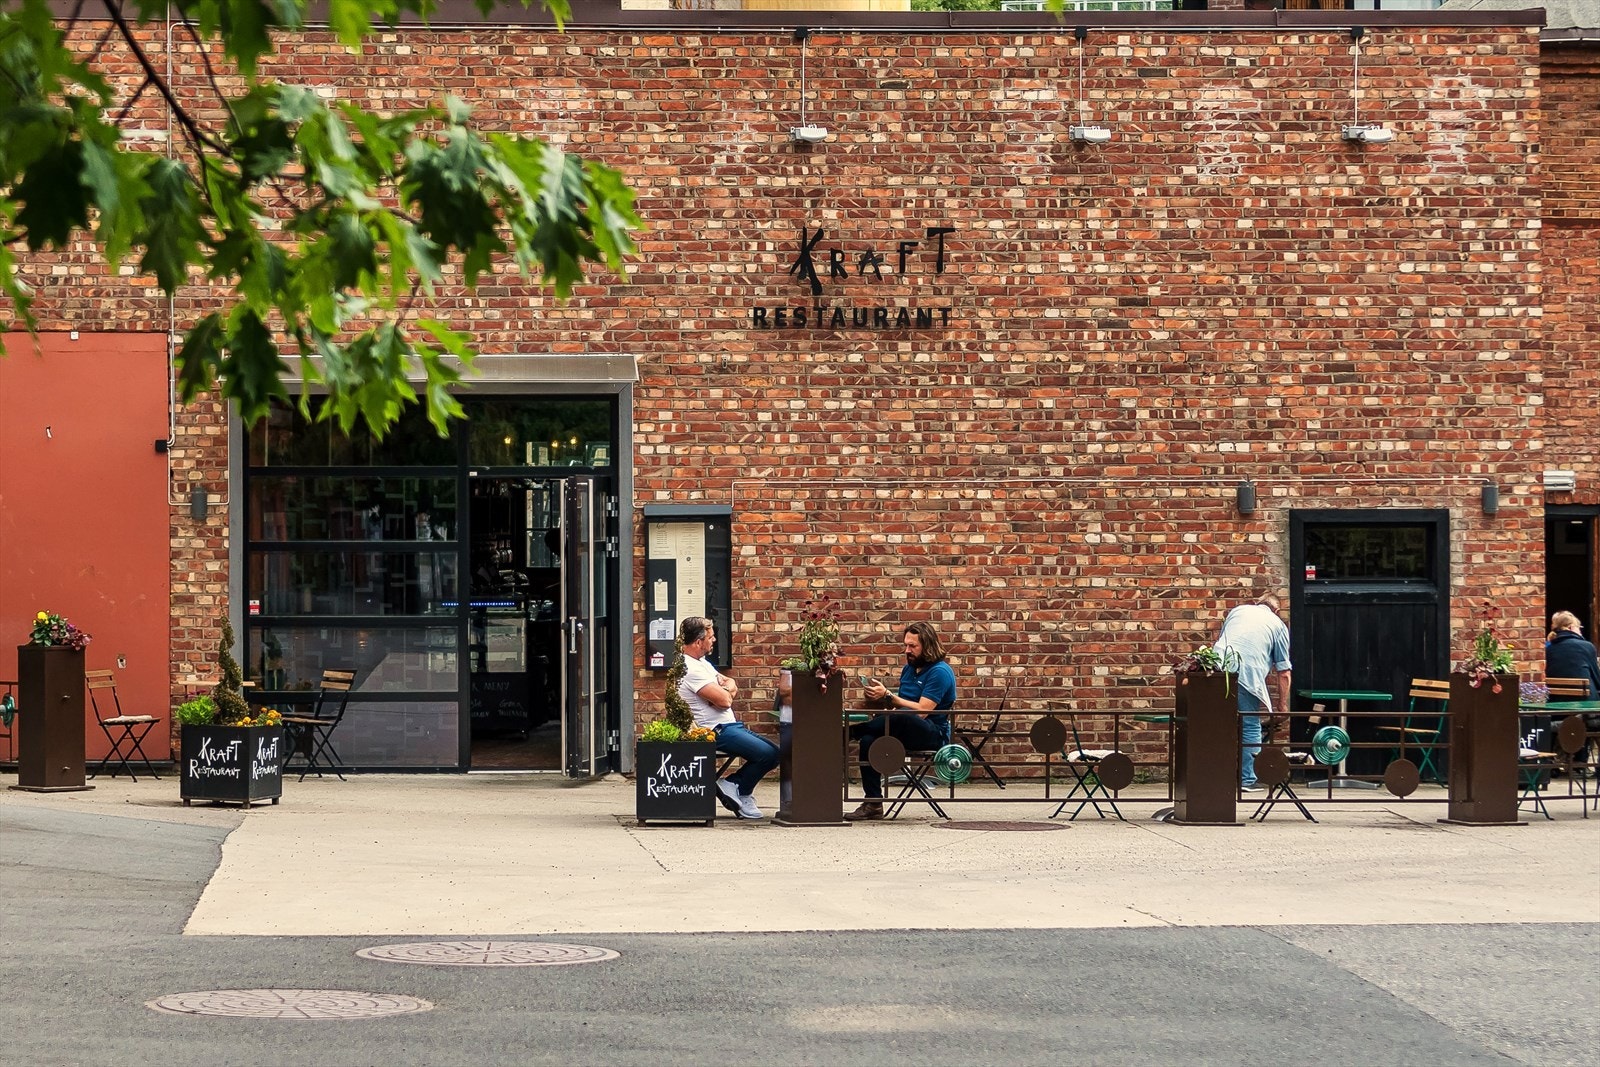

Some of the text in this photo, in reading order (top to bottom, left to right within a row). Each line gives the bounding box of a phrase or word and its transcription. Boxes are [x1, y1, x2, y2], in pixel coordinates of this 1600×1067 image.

[790, 226, 955, 295] KRAFT
[753, 306, 951, 328] RESTAURANT
[198, 736, 242, 766] KRAFT
[257, 736, 279, 766] KRAFT
[1519, 728, 1545, 749] AFT
[189, 759, 241, 779] RESTAURANT
[656, 753, 708, 784] KRAFT
[647, 776, 706, 798] RESTAURANT
